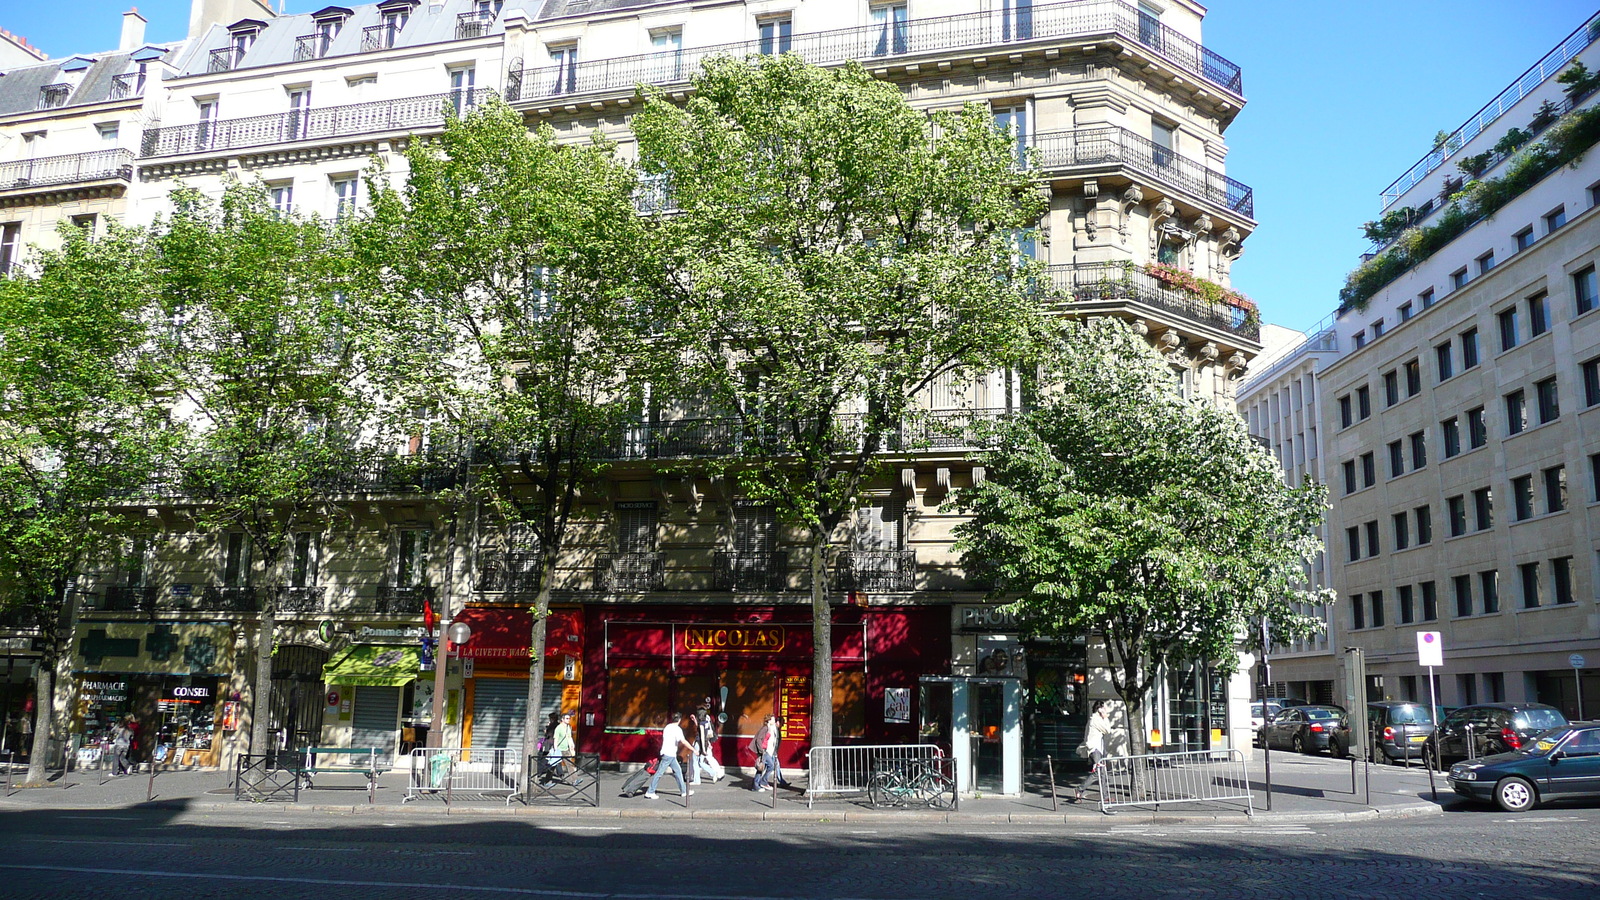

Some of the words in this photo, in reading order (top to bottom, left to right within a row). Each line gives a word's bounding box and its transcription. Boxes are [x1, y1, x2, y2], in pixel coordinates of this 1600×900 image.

[362, 626, 402, 637] Pomme
[691, 629, 779, 647] NICOLAS
[462, 648, 474, 657] LA
[474, 648, 508, 657] CIVETTE
[81, 680, 126, 691] PHARMACIE
[173, 687, 210, 697] CONSEIL
